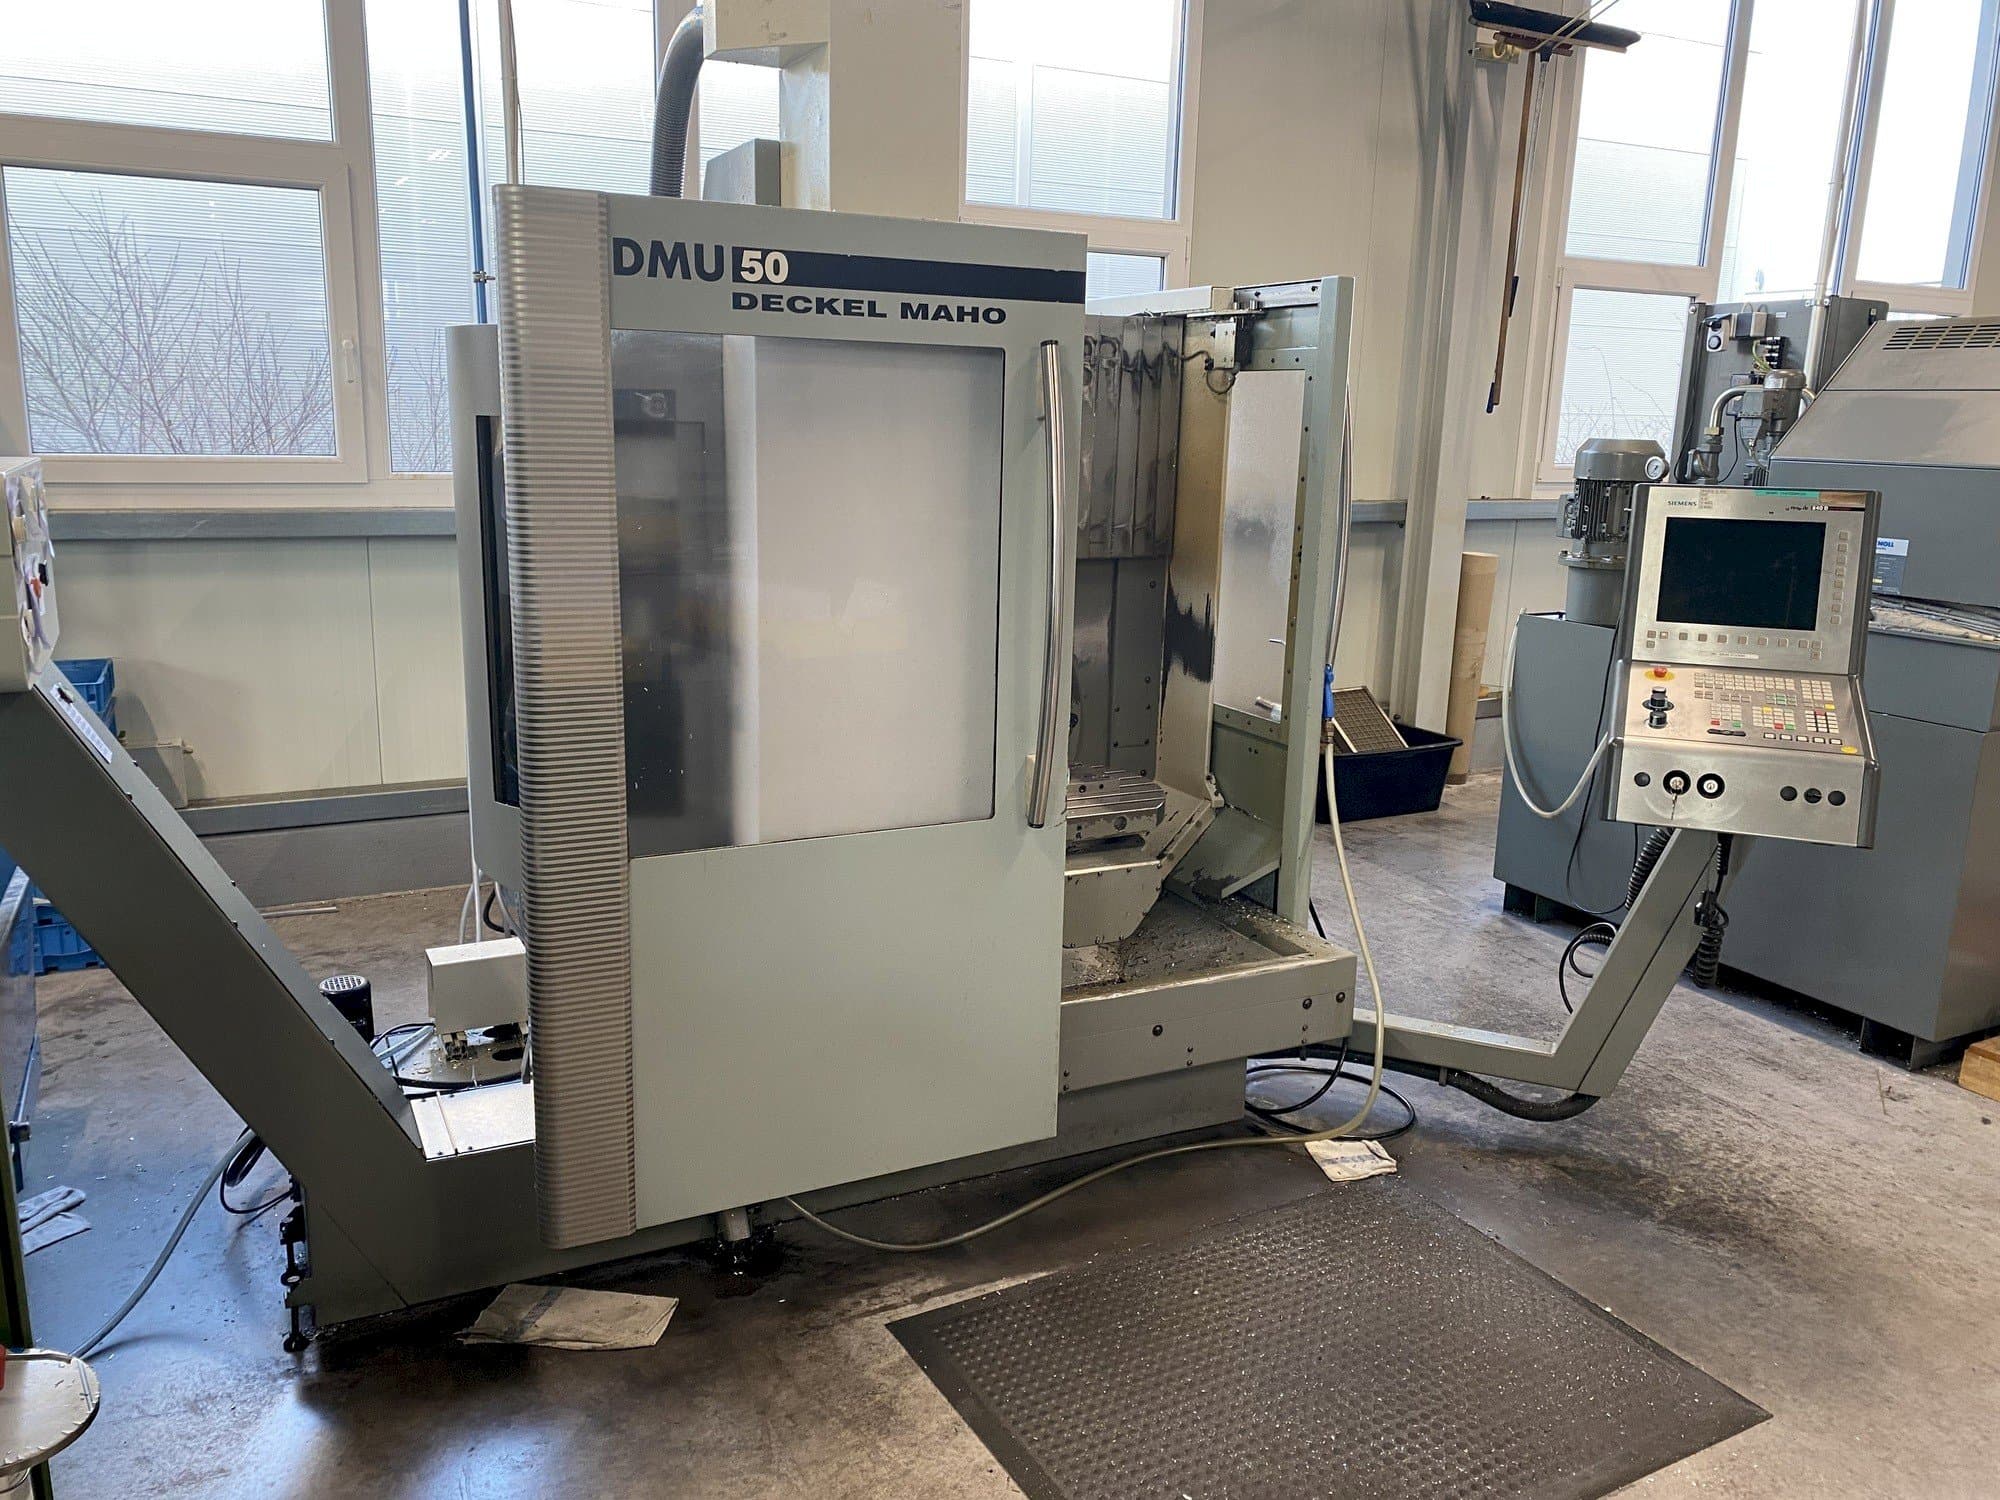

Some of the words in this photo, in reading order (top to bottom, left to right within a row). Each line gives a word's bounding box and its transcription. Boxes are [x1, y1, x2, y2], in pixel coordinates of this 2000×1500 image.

[612, 237, 725, 282] DMU
[740, 250, 789, 284] 50
[732, 292, 888, 318] DECKEL
[900, 302, 1007, 325] MAHO
